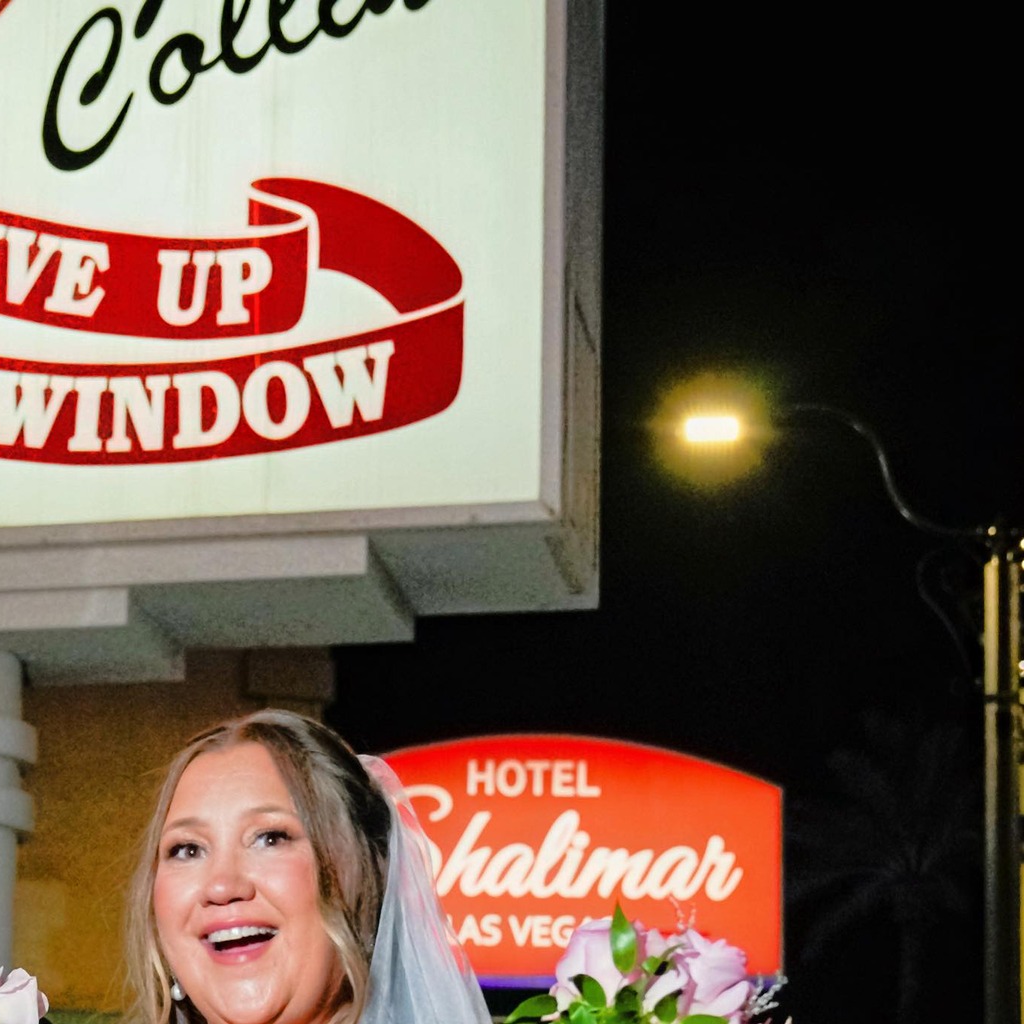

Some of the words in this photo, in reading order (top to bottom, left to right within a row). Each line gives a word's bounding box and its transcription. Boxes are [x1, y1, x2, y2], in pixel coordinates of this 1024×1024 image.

[157, 247, 273, 327] UP
[466, 760, 602, 797] HOTEL
[507, 914, 614, 949] VEG
